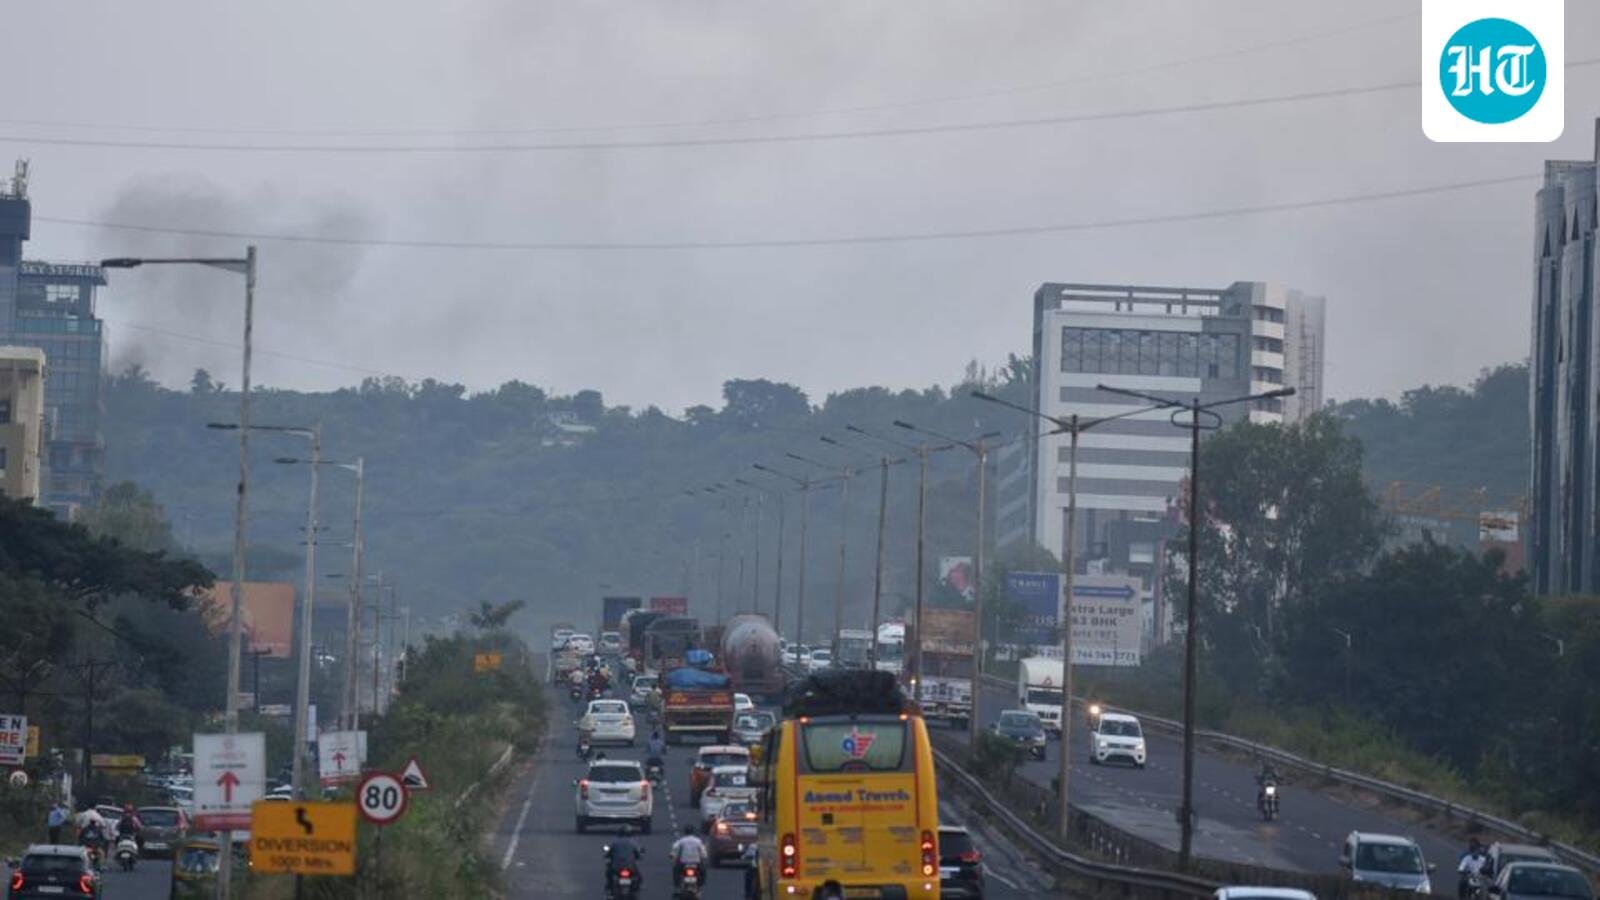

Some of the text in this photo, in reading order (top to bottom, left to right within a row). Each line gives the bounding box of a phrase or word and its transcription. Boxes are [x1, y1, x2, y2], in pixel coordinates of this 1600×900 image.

[1099, 604, 1135, 617] Large
[365, 785, 399, 811] 80
[256, 837, 352, 853] DIVERSION
